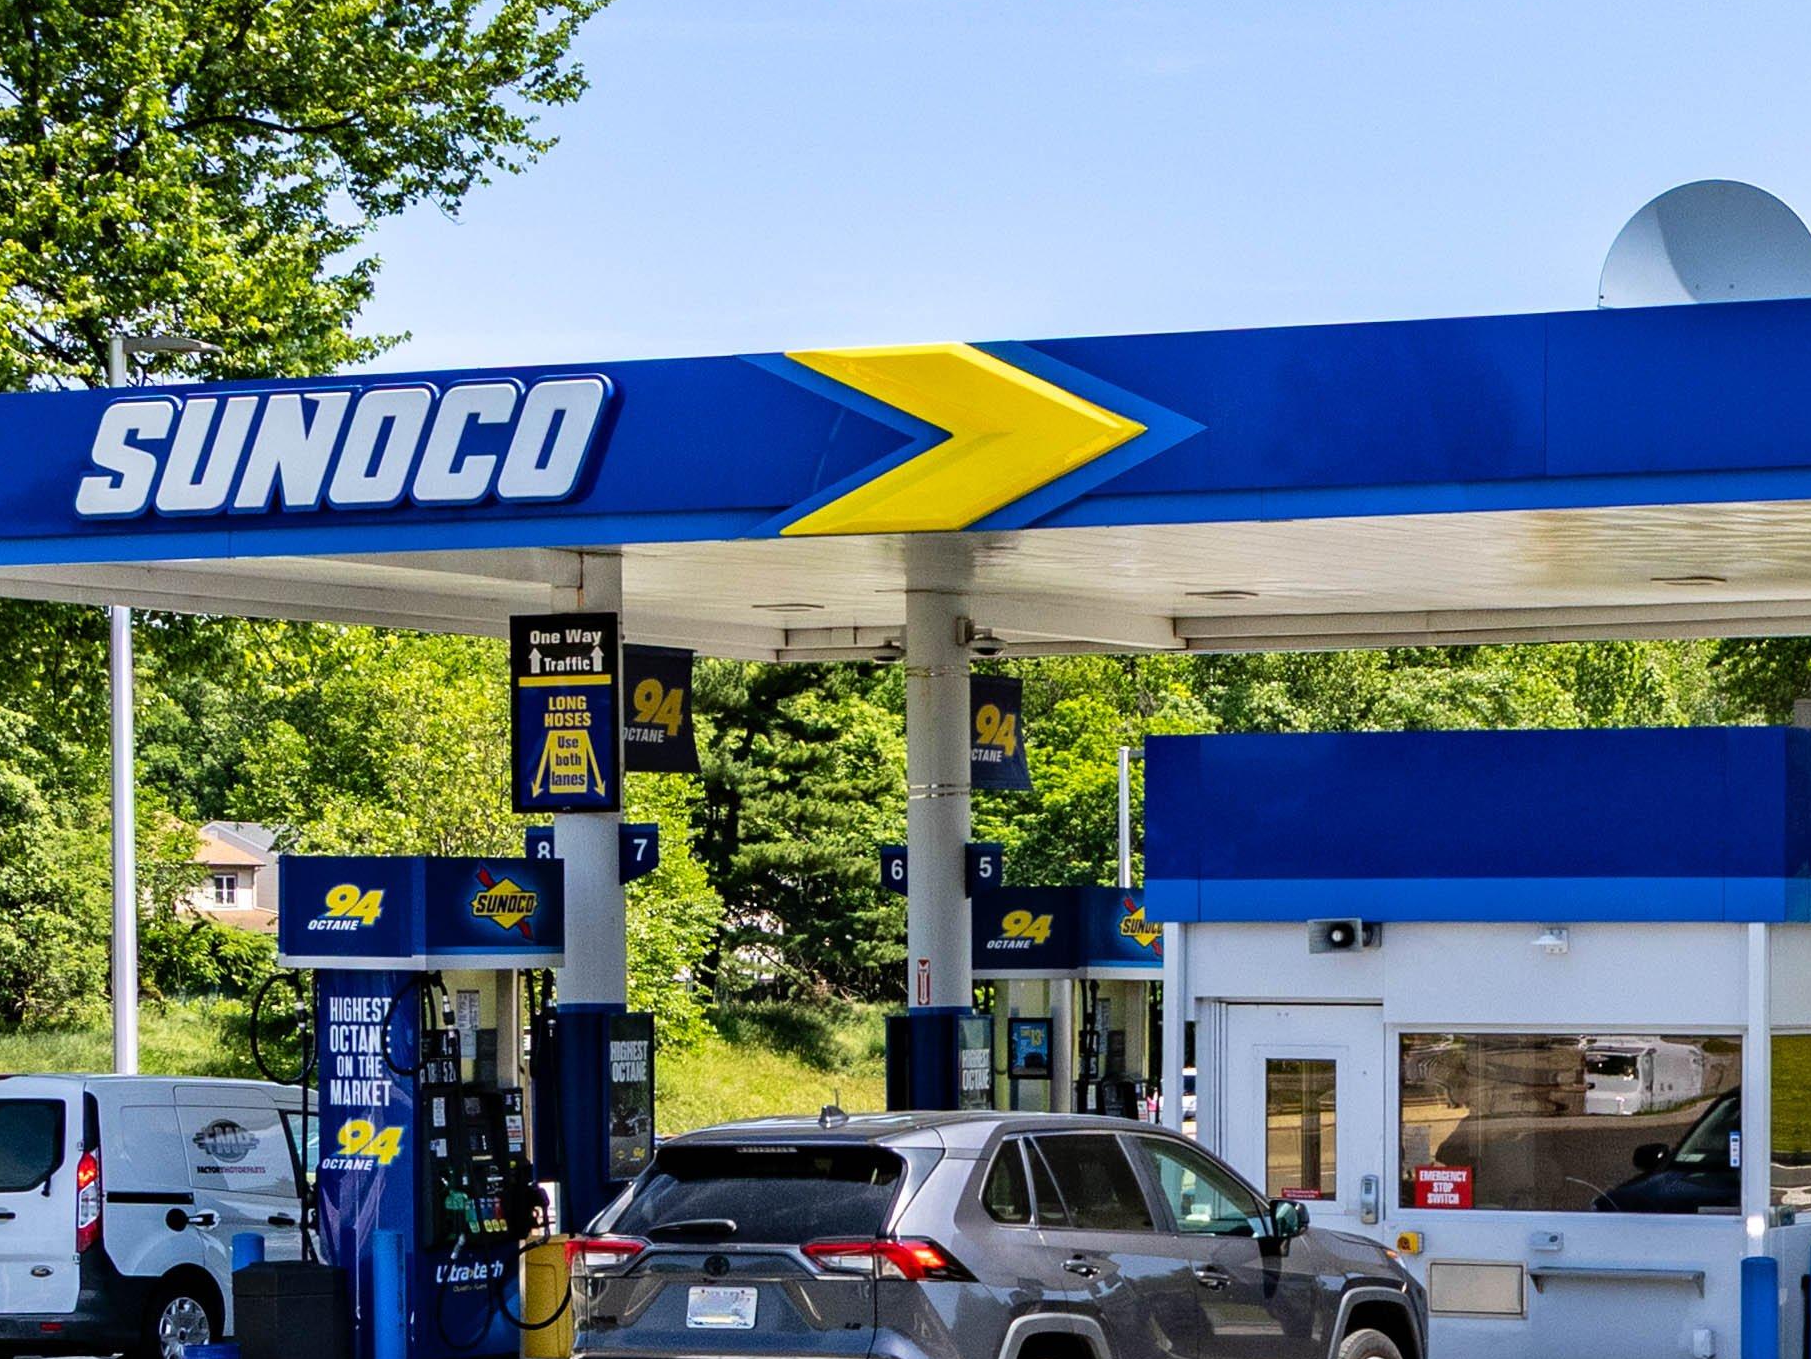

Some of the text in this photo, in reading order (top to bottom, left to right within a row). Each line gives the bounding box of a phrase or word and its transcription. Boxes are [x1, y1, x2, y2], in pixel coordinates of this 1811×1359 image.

[74, 378, 605, 516] SUNOCO
[530, 628, 602, 646] One Way
[543, 656, 591, 673] Traffic
[548, 695, 587, 712] LONG
[634, 678, 684, 736] 94
[544, 712, 592, 728] HOSES
[976, 704, 1017, 757] 94
[557, 735, 579, 749] Use
[555, 754, 582, 767] both
[971, 748, 1003, 763] CTANE
[551, 772, 586, 787] lanes
[537, 841, 551, 859] 8
[633, 840, 648, 861] 7
[891, 859, 903, 880] 6
[978, 856, 993, 878] 5
[325, 884, 385, 926] 94
[475, 894, 535, 914] SUNOCO
[307, 919, 359, 931] OCTANE
[1001, 909, 1053, 945] 94
[986, 939, 1030, 949] OCTANE
[329, 996, 392, 1022] HIGHEST
[610, 1041, 648, 1061] HIGHEST
[337, 1056, 382, 1077] ON THE
[611, 1062, 647, 1082] OCTANE
[330, 1080, 392, 1106] MARKET
[514, 1097, 522, 1112] 3
[337, 1119, 403, 1165] 94
[321, 1158, 373, 1171] OCTANE
[1420, 1170, 1467, 1182] EMERGENCY
[1433, 1183, 1454, 1192] STOP
[1427, 1193, 1460, 1204] SWITCH
